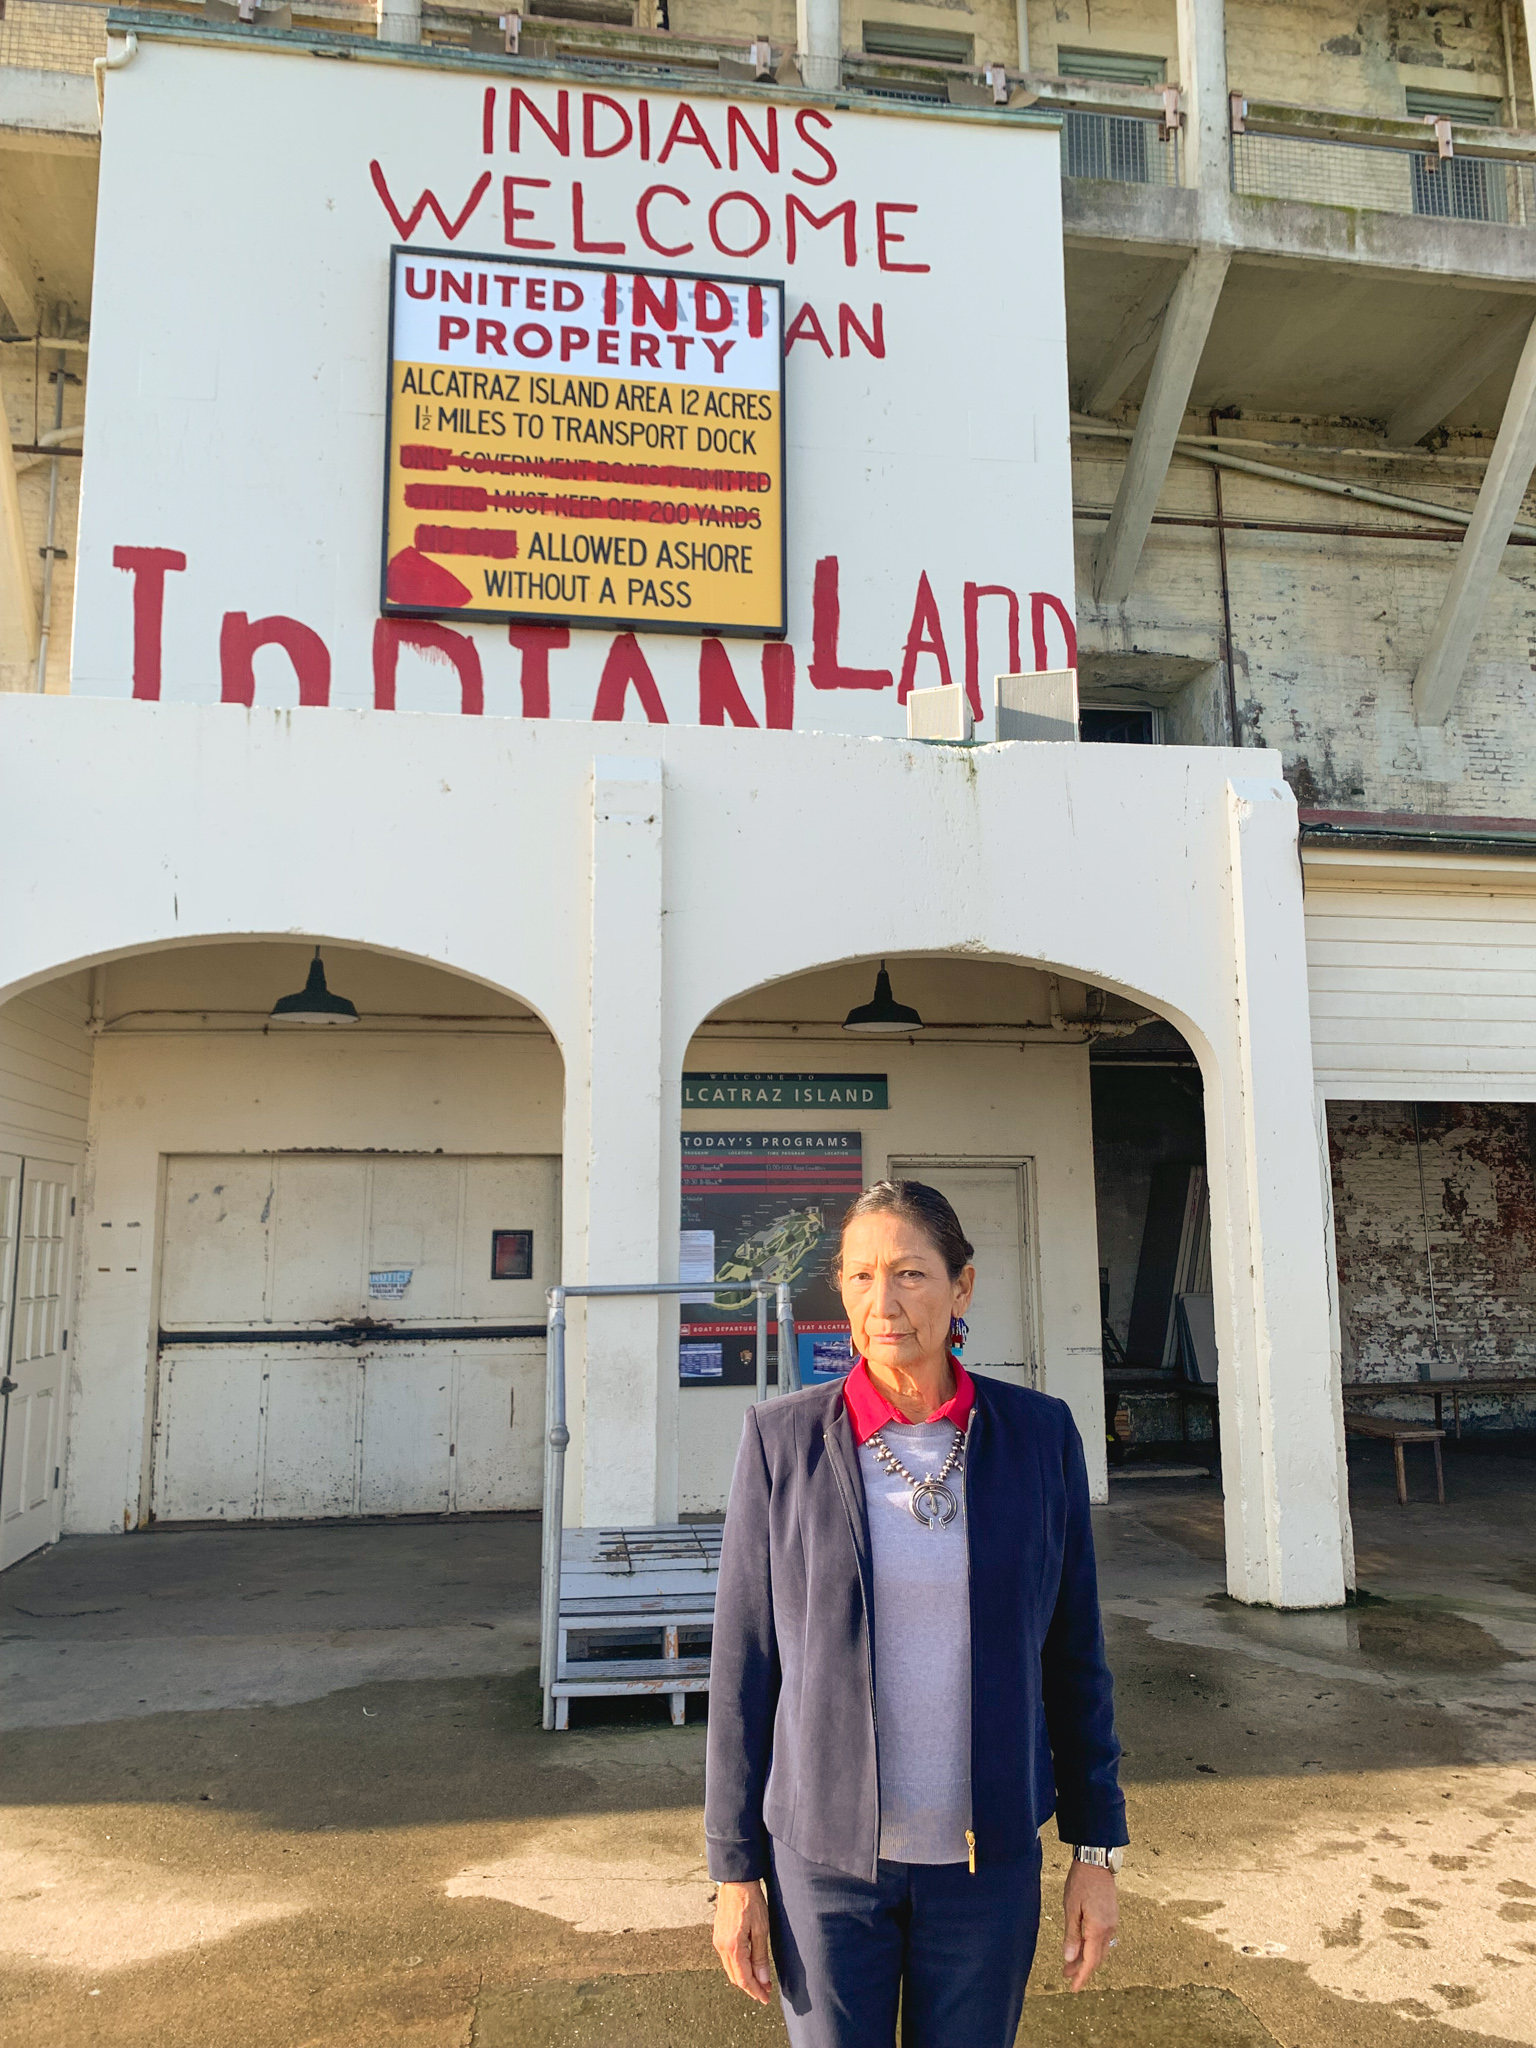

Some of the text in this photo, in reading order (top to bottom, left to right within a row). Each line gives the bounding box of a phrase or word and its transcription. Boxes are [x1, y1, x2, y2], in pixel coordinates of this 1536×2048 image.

[482, 87, 838, 186] INDIANS
[369, 159, 931, 273] WELCOME
[404, 266, 584, 313] UNITED
[438, 315, 737, 374] PROPERTY
[401, 366, 772, 421] ALCATRAZ ISLAND AREA 12 ACRES
[438, 406, 506, 436] MILES
[513, 412, 544, 439] TO
[551, 415, 689, 450] TRANSPORT
[697, 426, 757, 455] DOCK
[494, 489, 549, 515] MUST
[606, 497, 642, 522] OFF
[648, 500, 690, 525] 200
[694, 502, 762, 530] YARDS
[528, 531, 647, 566] ALLOWED
[656, 540, 753, 574] ASHORE
[484, 569, 692, 608] WITHOUT A PASS
[685, 1087, 875, 1104] LCATRAZ ISLAND
[683, 1136, 849, 1147] TODAY'S PROGRAMS
